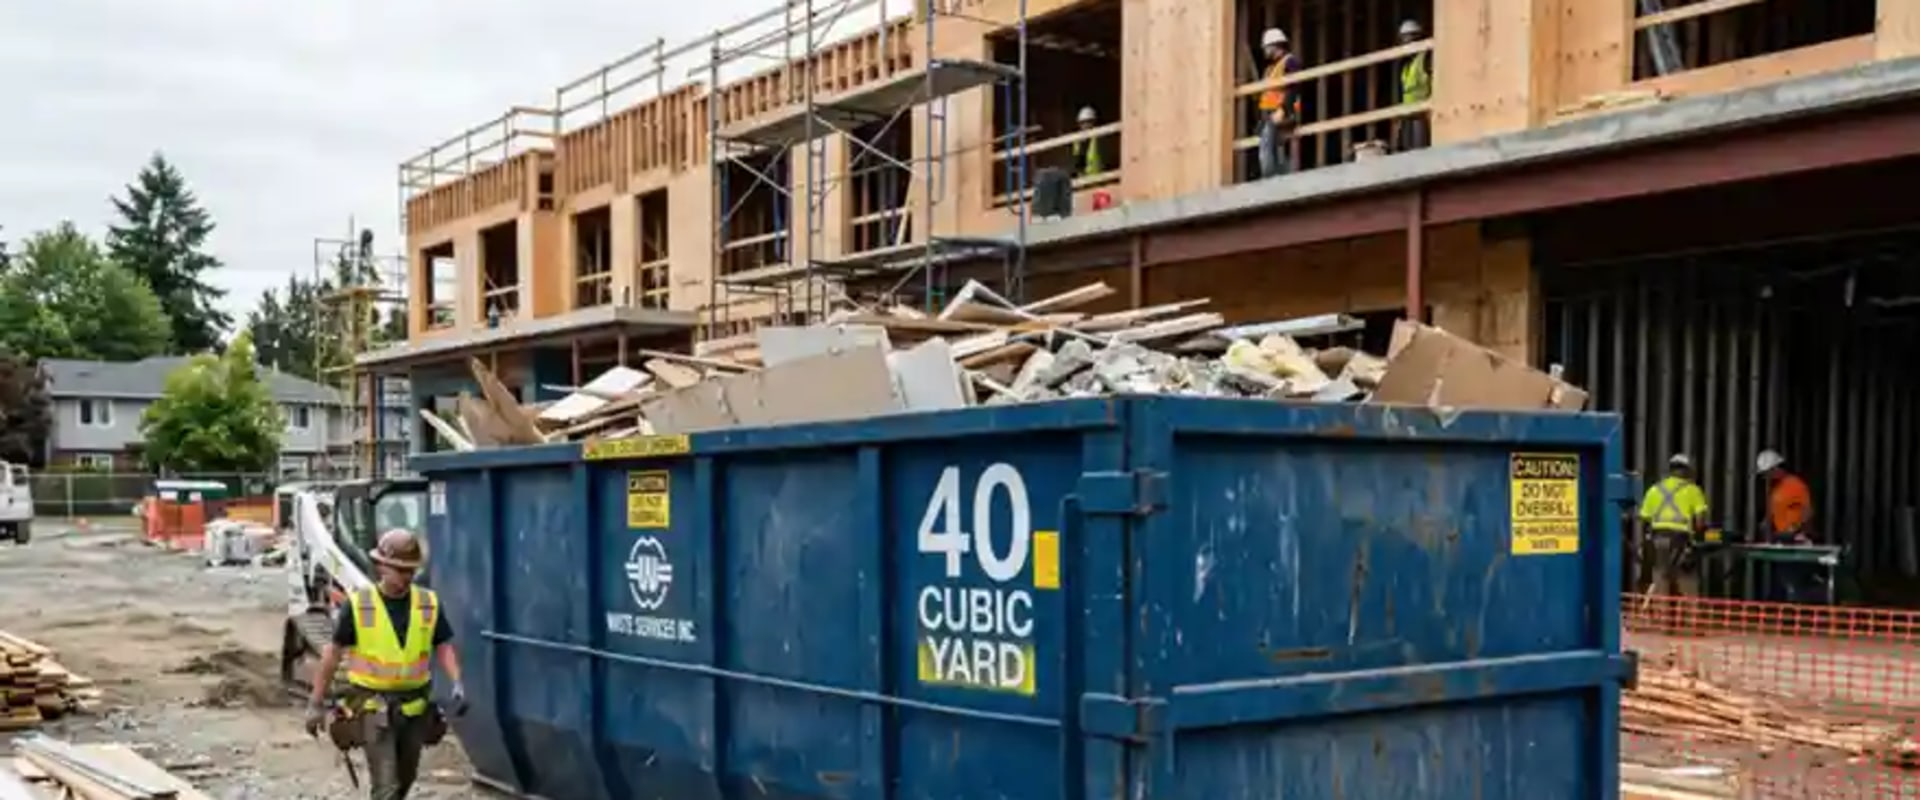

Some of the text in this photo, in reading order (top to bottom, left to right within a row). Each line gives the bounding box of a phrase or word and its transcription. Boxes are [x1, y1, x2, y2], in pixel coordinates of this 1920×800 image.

[1517, 501, 1575, 517] OVERFILL
[1523, 483, 1568, 498] DO NOT
[918, 462, 1030, 581] 40
[918, 585, 1034, 637] CUBIC
[927, 636, 1026, 688] YARD
